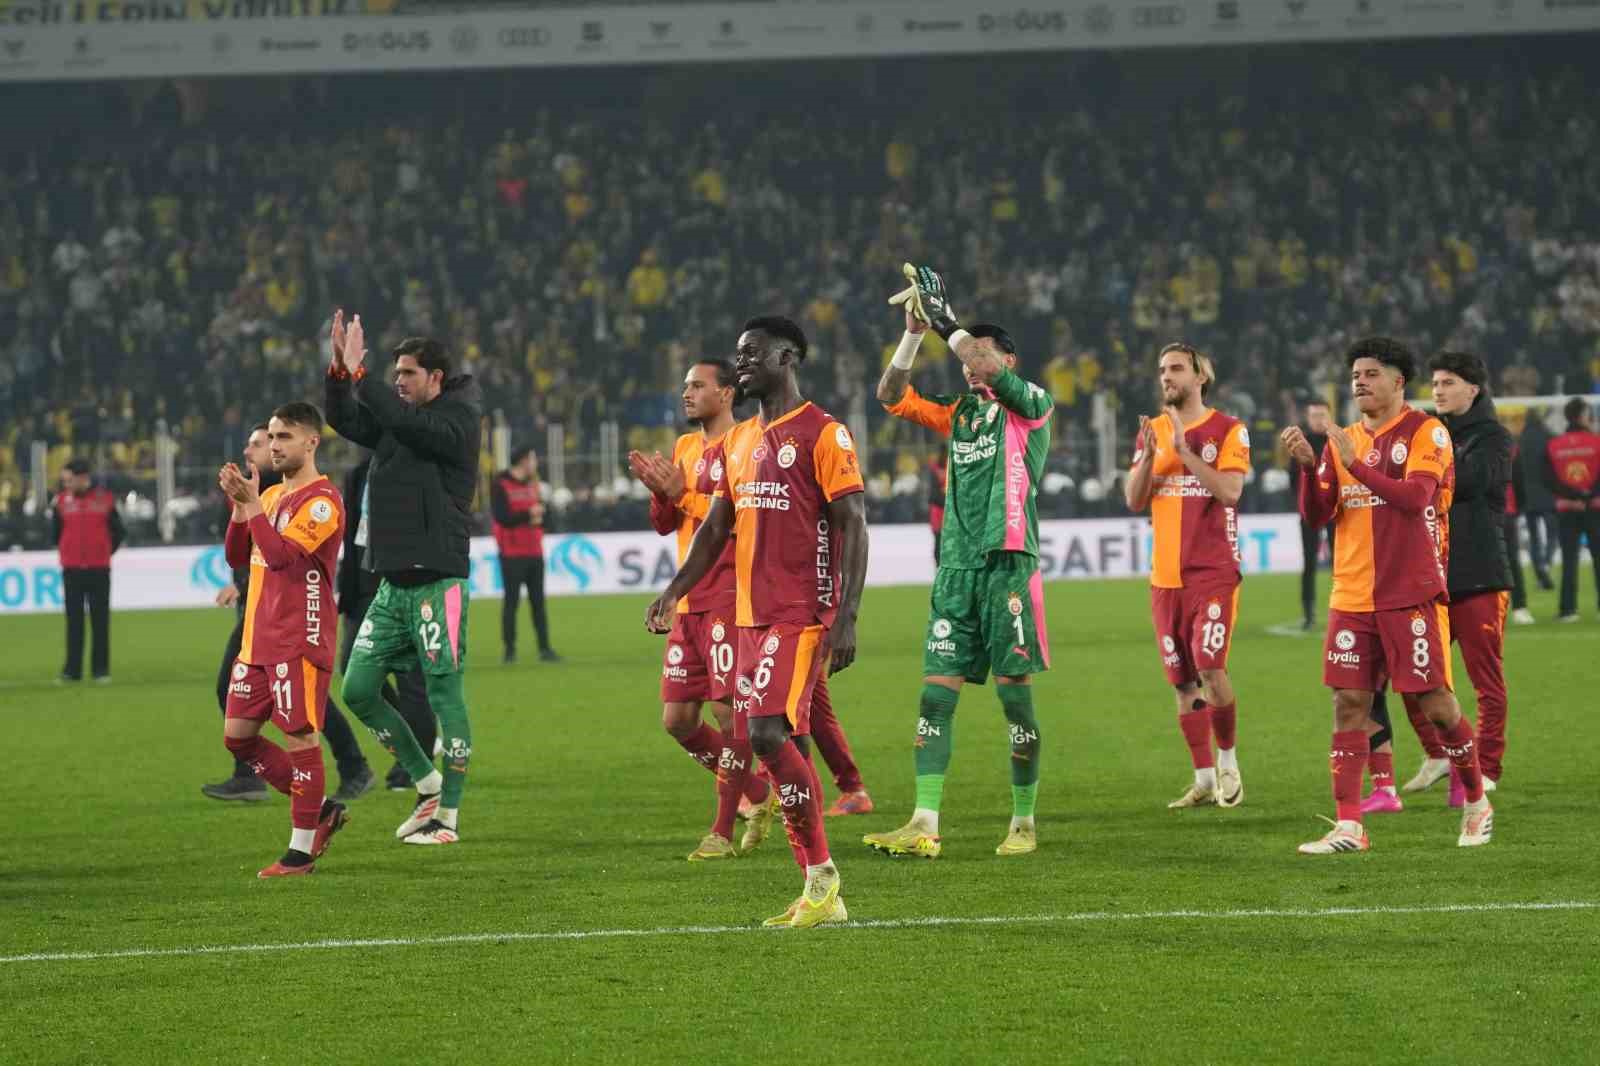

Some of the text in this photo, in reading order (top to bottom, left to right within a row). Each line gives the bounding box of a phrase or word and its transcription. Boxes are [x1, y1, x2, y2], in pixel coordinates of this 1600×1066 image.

[817, 518, 833, 608] ALFEMO
[306, 569, 321, 647] ALFEMO
[419, 621, 442, 651] 12
[1013, 615, 1025, 646] 1
[1202, 621, 1226, 649] 18
[709, 642, 734, 674] 10
[1327, 650, 1360, 664] Lydia
[1413, 637, 1430, 668] 8
[228, 681, 251, 695] ydia
[755, 656, 775, 689] 6
[272, 679, 292, 709] 11
